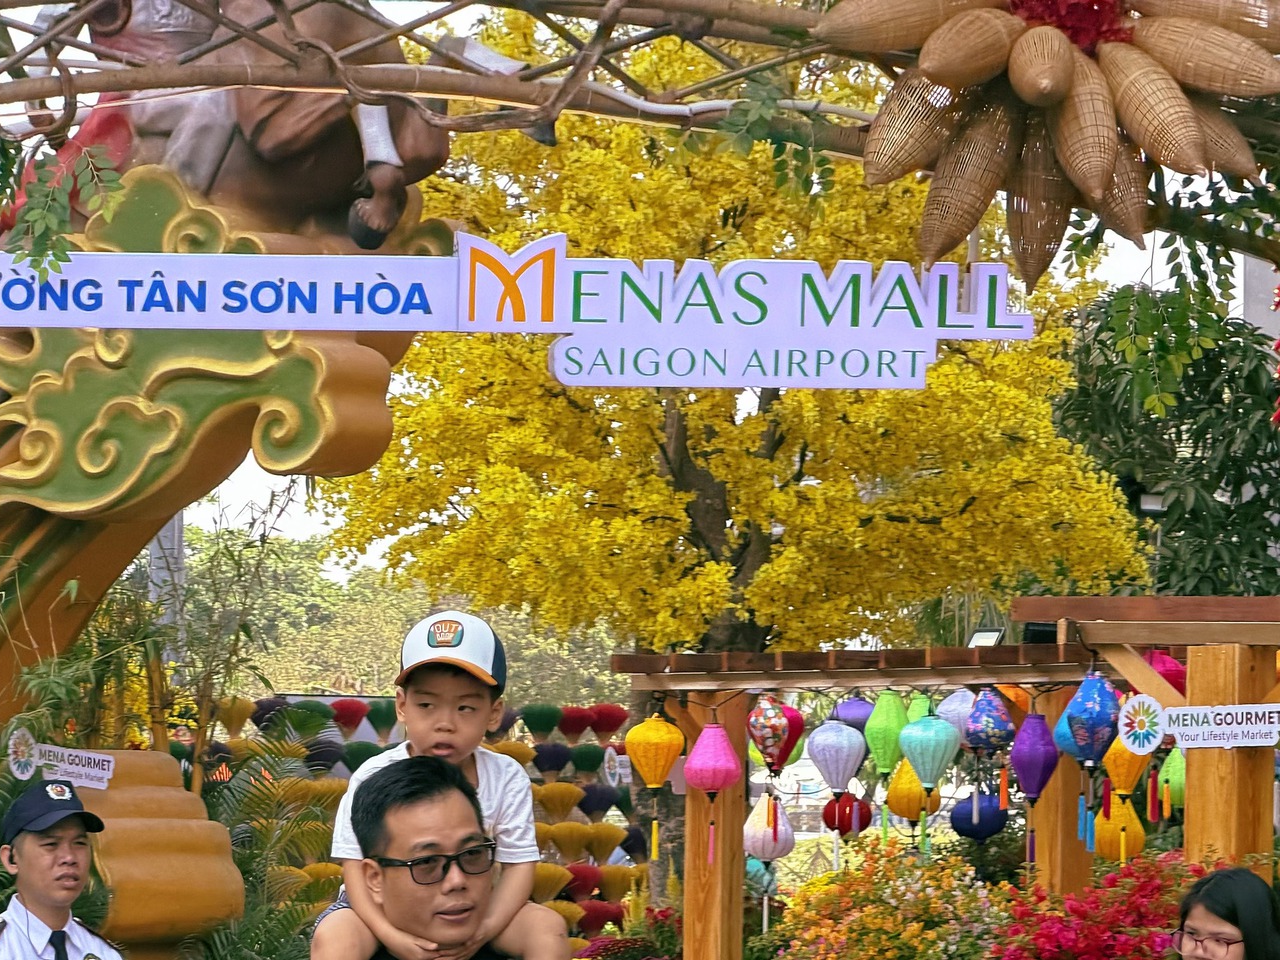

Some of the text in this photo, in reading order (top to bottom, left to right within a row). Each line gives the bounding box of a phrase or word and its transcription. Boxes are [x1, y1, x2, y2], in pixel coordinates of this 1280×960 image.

[118, 271, 206, 314] TÂN
[222, 276, 318, 316] SƠN
[334, 272, 433, 316] HÒA
[467, 246, 1025, 330] MENAS MALL
[564, 346, 926, 378] SAIGON AIRPORT
[434, 623, 459, 633] OUT
[1168, 711, 1280, 728] MENA GOURMET
[1179, 730, 1273, 743] Your Lifestyle Market
[39, 749, 66, 764] MENA
[67, 754, 112, 772] GOURMET
